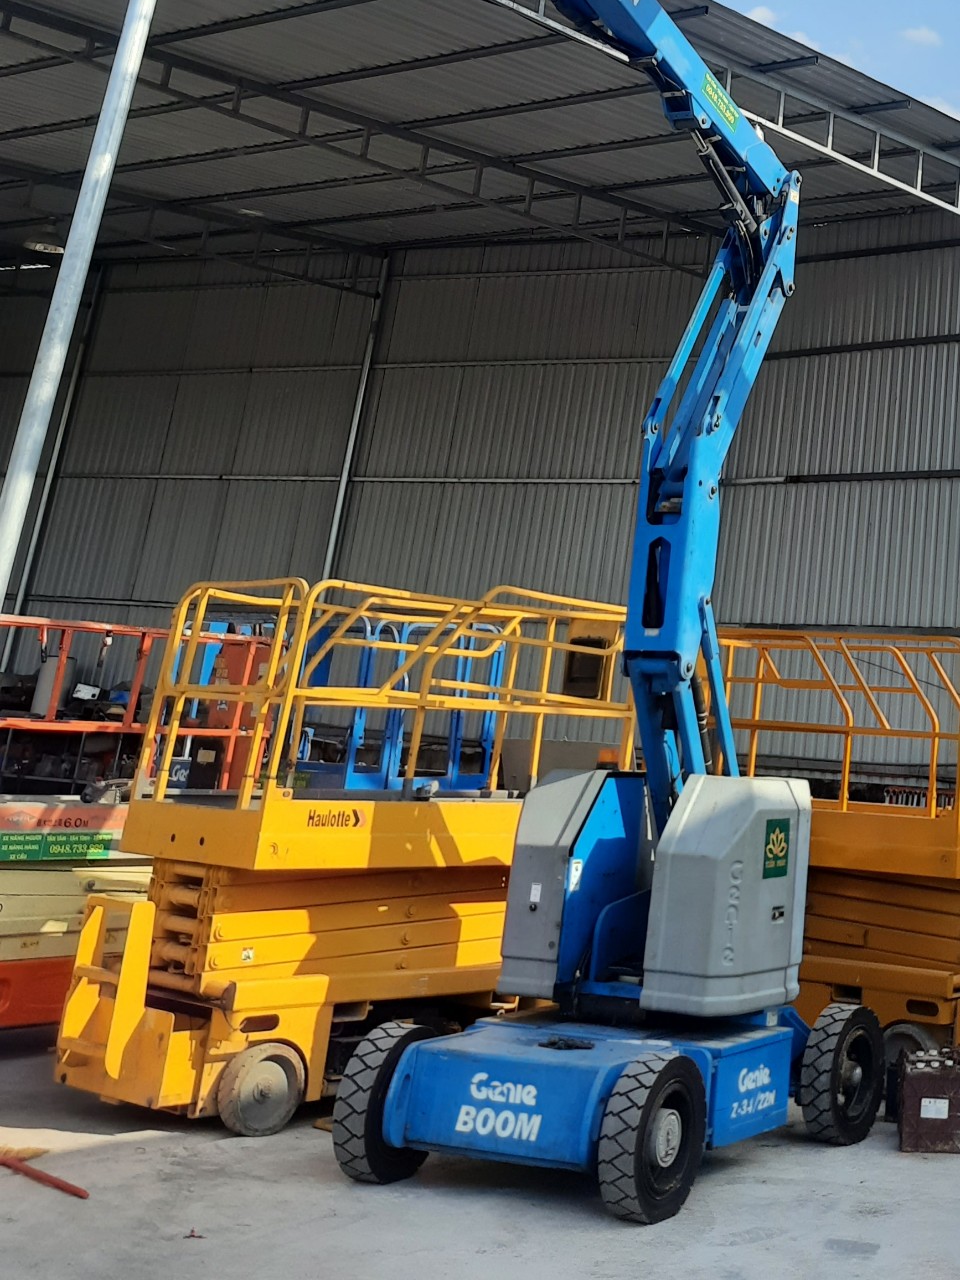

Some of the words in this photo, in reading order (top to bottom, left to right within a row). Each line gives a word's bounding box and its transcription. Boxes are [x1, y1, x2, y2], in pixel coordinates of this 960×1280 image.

[307, 809, 351, 827] Haulotte
[470, 1072, 537, 1106] Genie
[738, 1064, 771, 1092] Genie
[731, 1089, 776, 1119] Z-34/22N
[455, 1104, 542, 1141] BOOM
